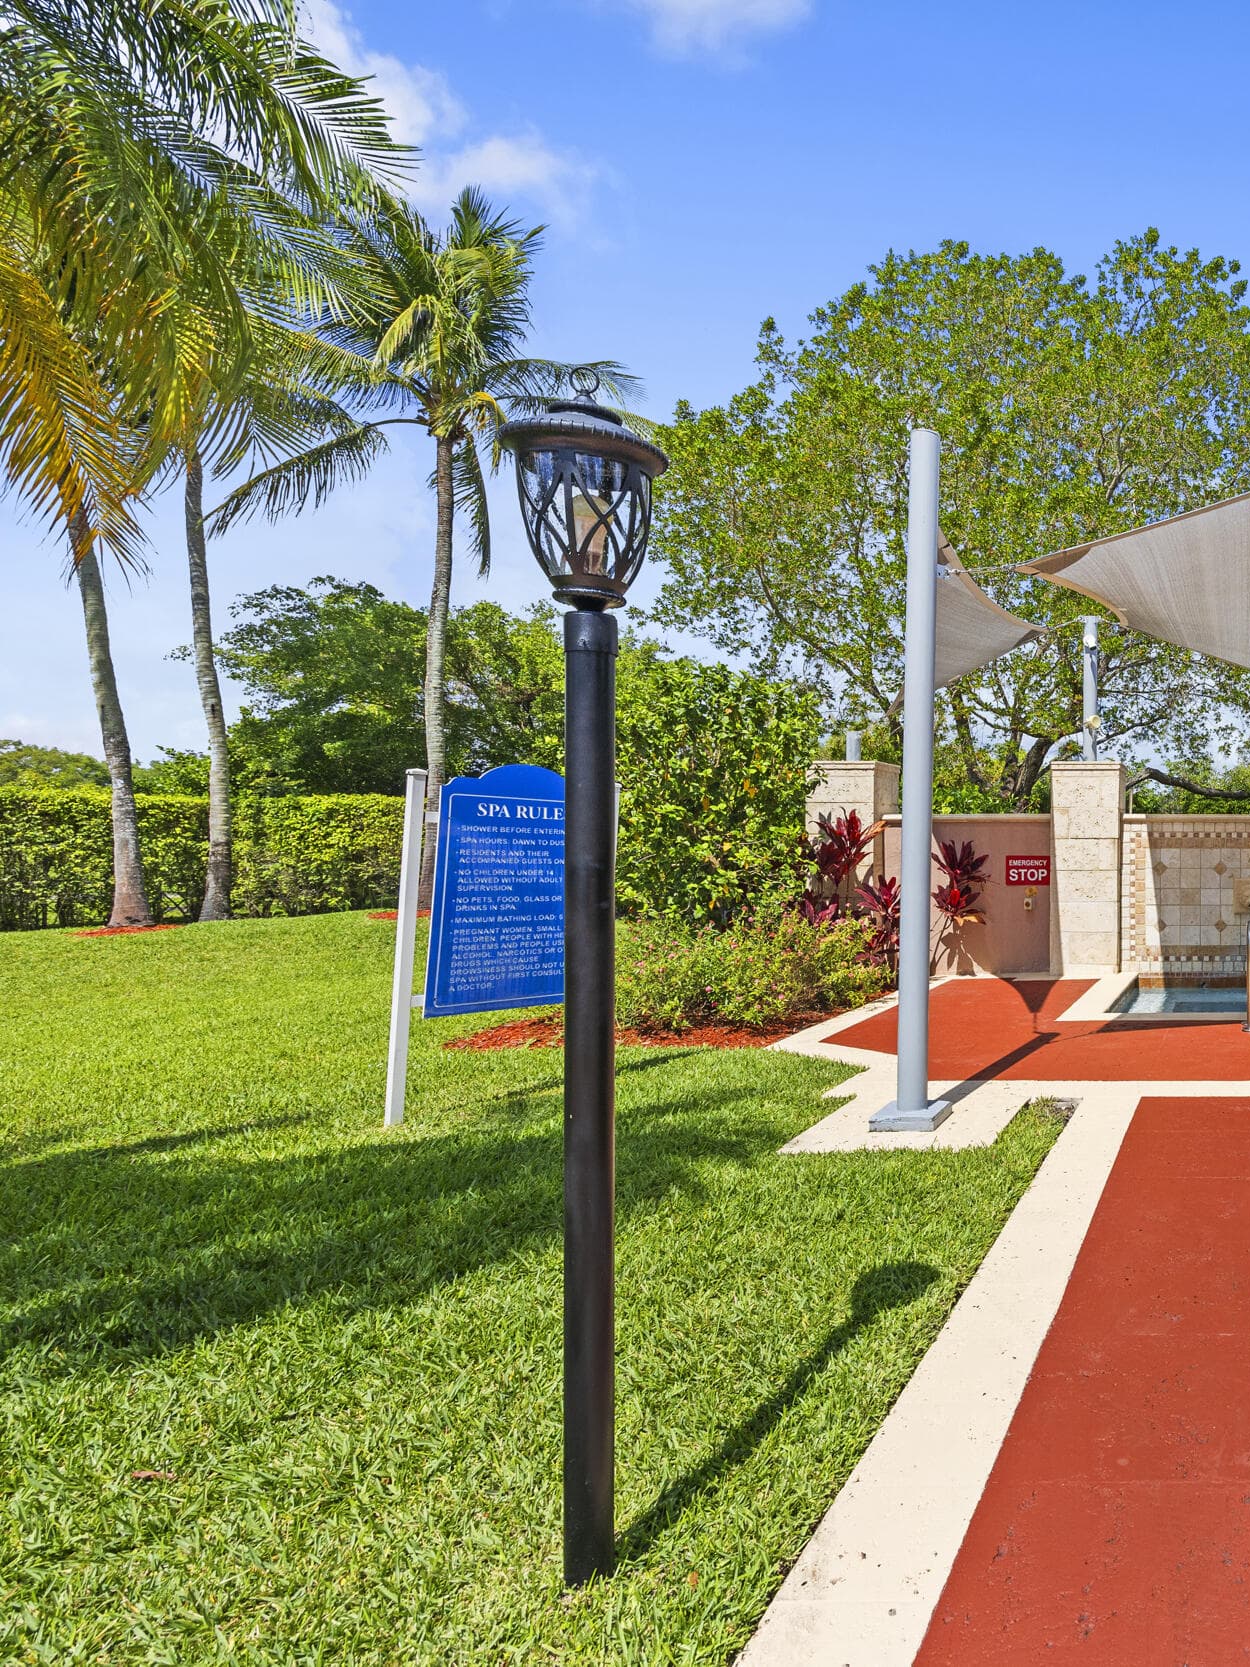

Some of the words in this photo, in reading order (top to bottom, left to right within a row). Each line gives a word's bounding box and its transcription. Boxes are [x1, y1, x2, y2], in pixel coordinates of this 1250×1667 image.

[477, 803, 510, 818] SPA
[516, 806, 565, 820] RULE
[1009, 869, 1047, 881] STOP
[452, 943, 499, 951] PROBLEMS
[450, 966, 506, 975] DROWSINESS
[468, 973, 505, 982] WITHOUT
